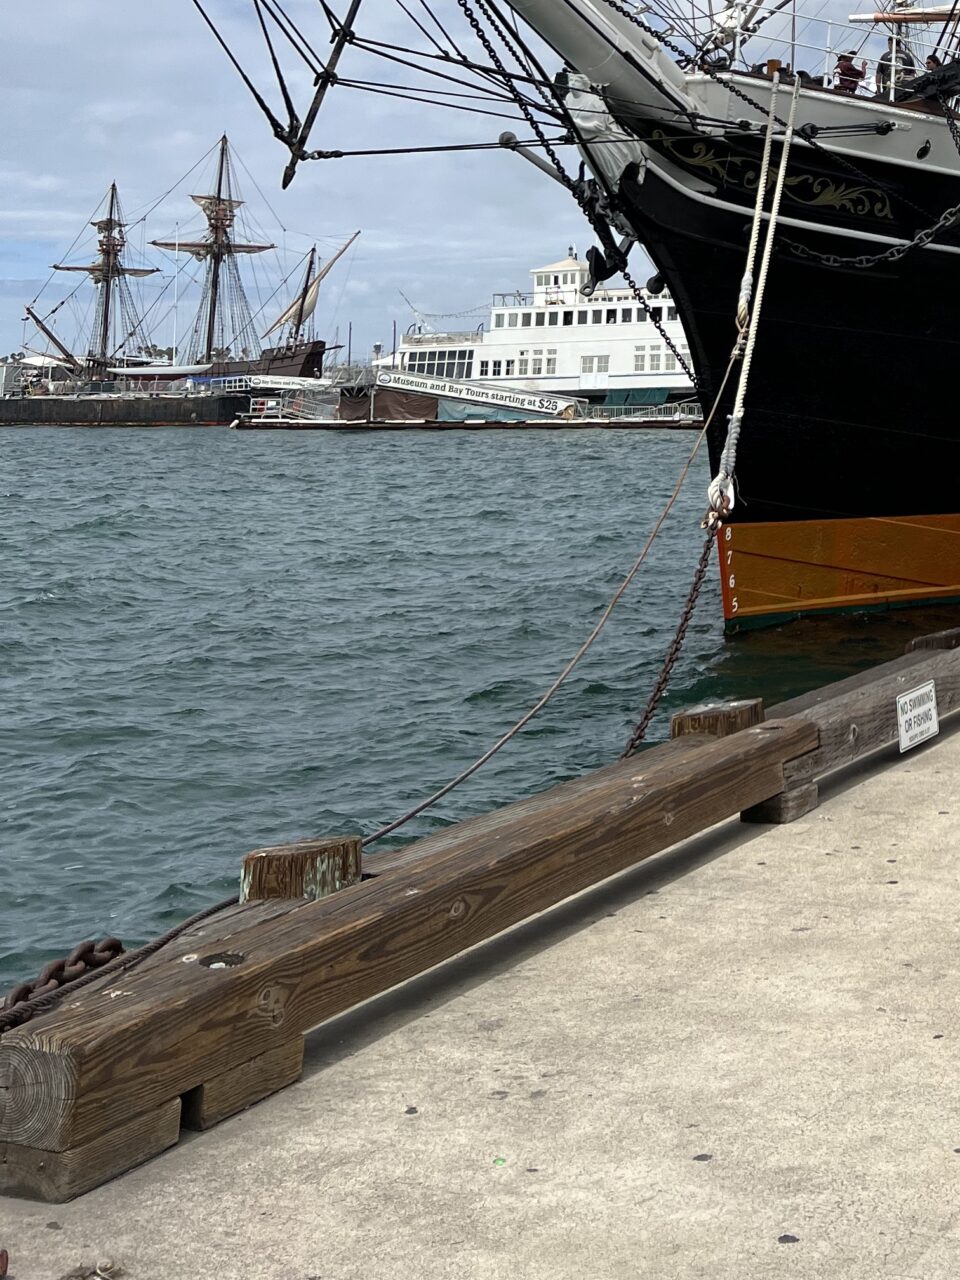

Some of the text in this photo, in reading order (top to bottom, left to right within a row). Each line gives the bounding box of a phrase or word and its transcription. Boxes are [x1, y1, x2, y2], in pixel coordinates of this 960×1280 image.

[392, 376, 428, 389] Museum
[429, 383, 447, 392] and
[448, 385, 464, 396] Bay
[465, 387, 489, 399] Tours
[491, 393, 526, 406] starting
[725, 527, 732, 541] 8
[727, 550, 733, 565] 7
[729, 574, 735, 588] 6
[732, 597, 738, 613] 5
[900, 689, 934, 717] NO SWIMMING
[904, 708, 933, 733] OR FISHING
